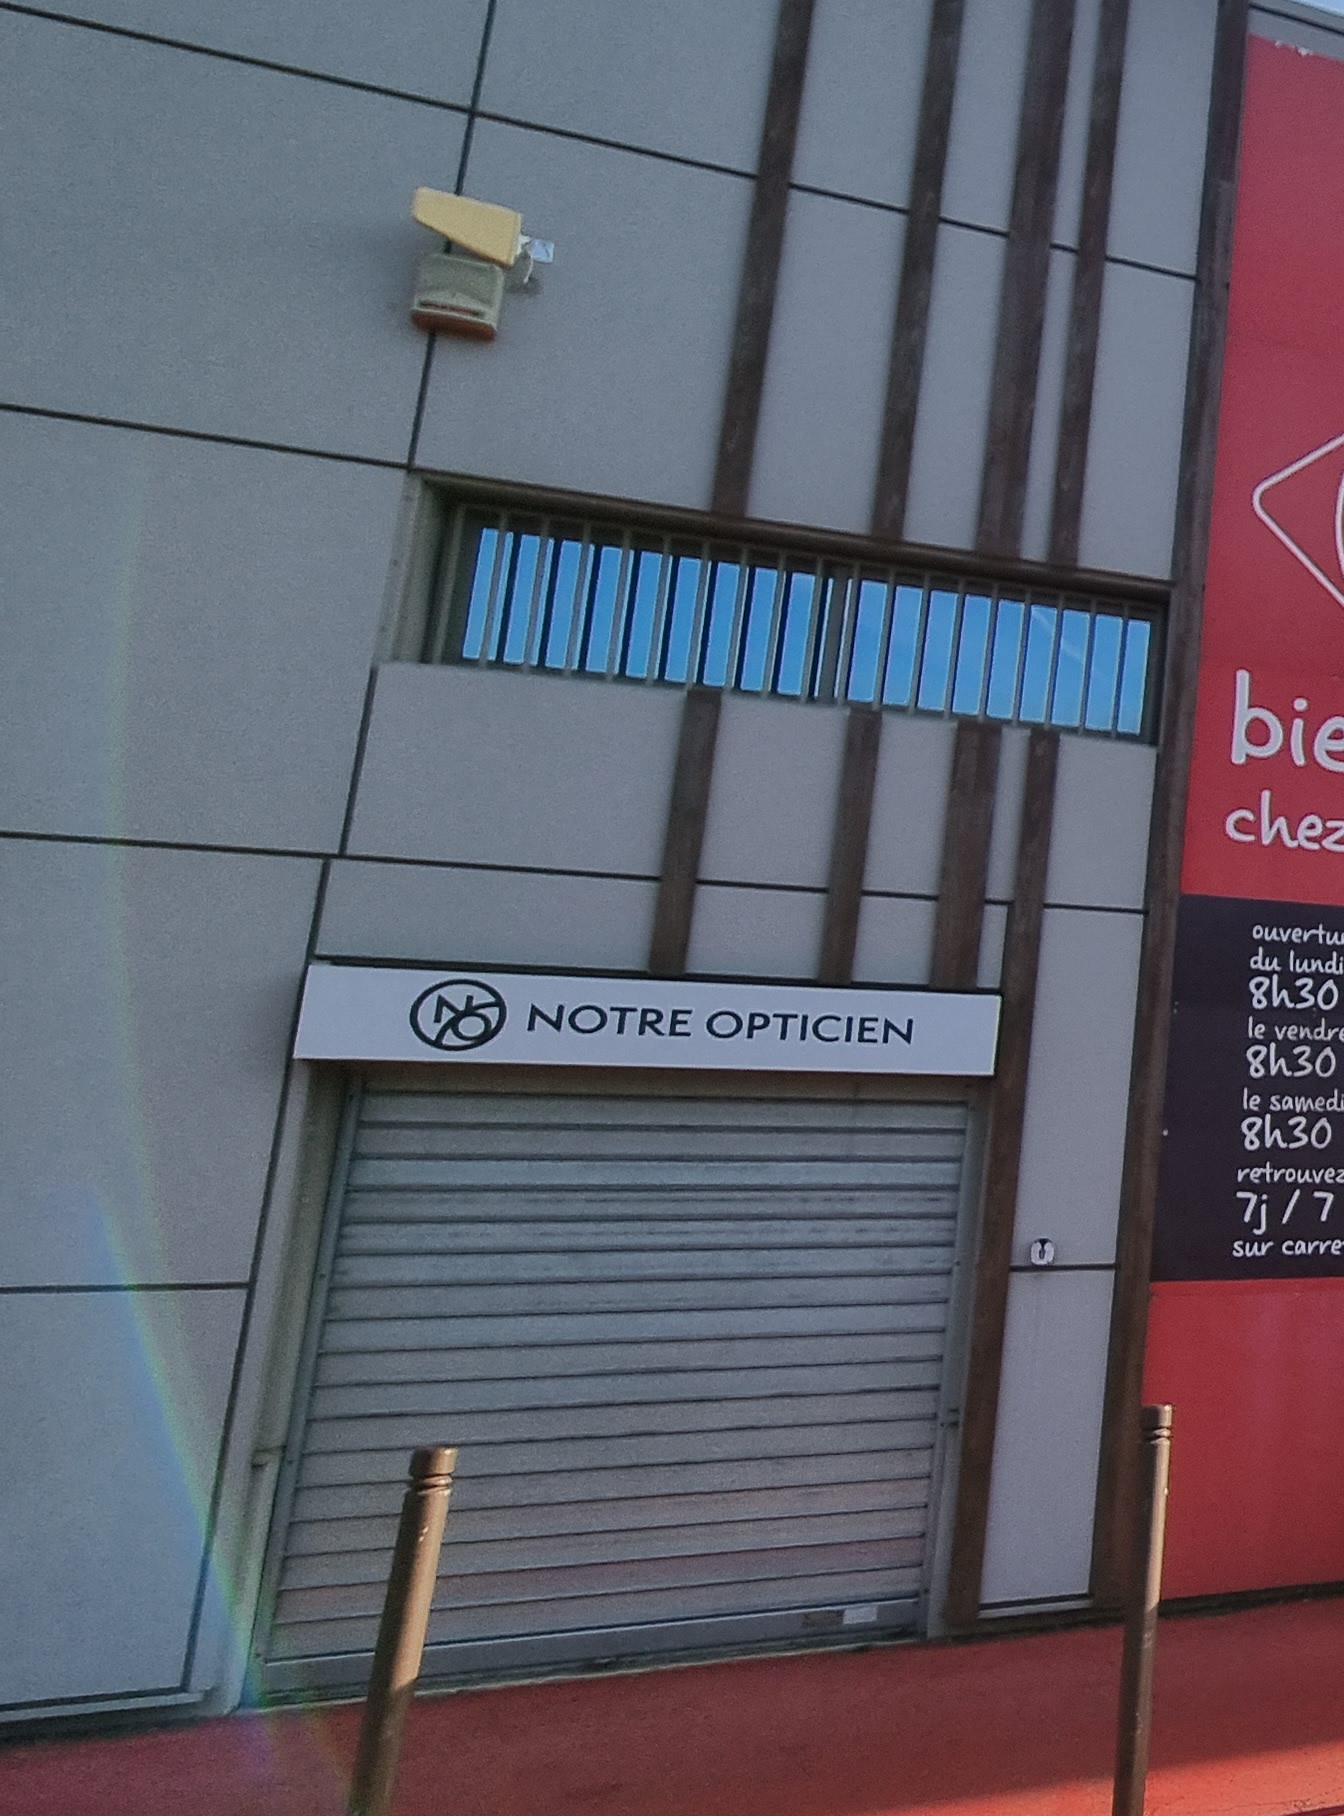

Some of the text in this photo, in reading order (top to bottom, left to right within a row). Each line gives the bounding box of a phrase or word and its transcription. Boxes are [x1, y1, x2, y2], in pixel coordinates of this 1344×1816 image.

[1250, 947, 1281, 972] du
[1289, 950, 1344, 976] lundi
[1248, 975, 1340, 1011] 8h30
[527, 1003, 692, 1038] NOTRE
[706, 1009, 914, 1046] OPTICIEN
[1247, 1016, 1266, 1040] le
[1245, 1043, 1337, 1079] 8h30
[1242, 1088, 1261, 1112] le
[1240, 1116, 1332, 1151] 8h30
[1235, 1191, 1268, 1235] 7j
[1281, 1189, 1300, 1225] /
[1313, 1192, 1335, 1222] 7
[1232, 1237, 1274, 1257] sur
